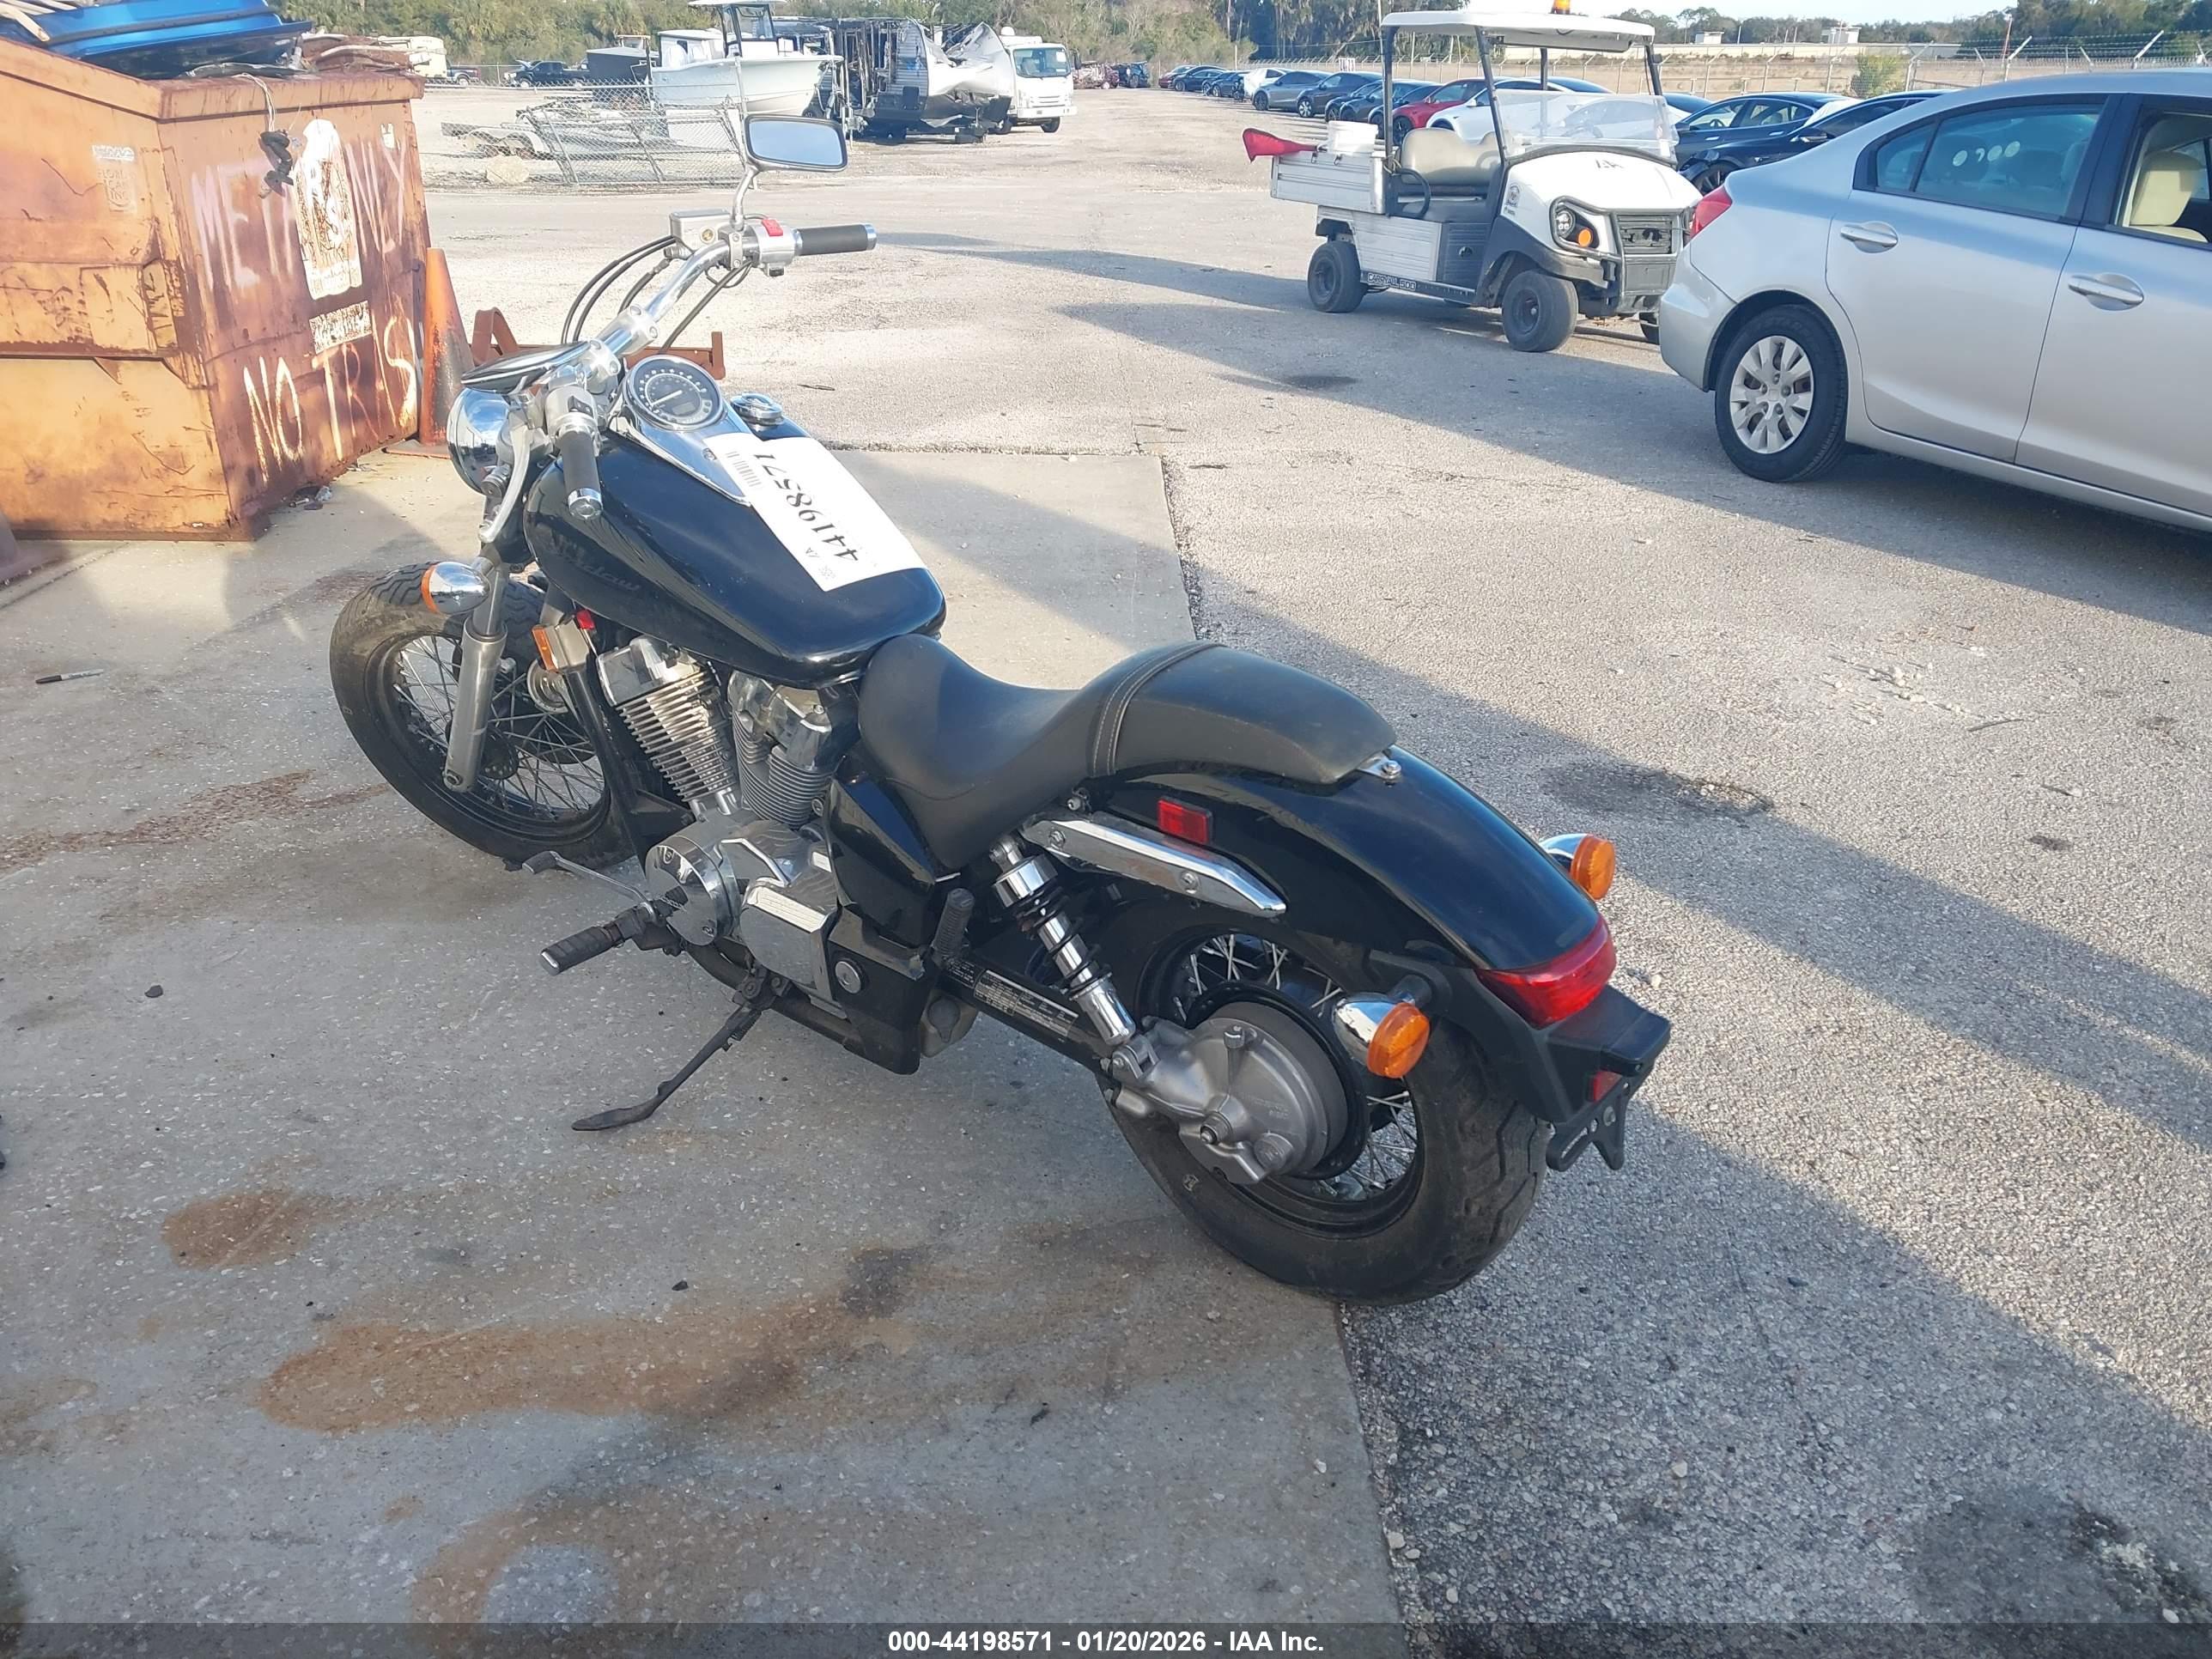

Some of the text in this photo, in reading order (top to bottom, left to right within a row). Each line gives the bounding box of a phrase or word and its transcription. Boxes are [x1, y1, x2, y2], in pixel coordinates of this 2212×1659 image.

[191, 155, 298, 293] MET
[1367, 272, 1417, 291] CARRYALL 500
[243, 356, 304, 487] NO
[753, 453, 860, 562] 44198571
